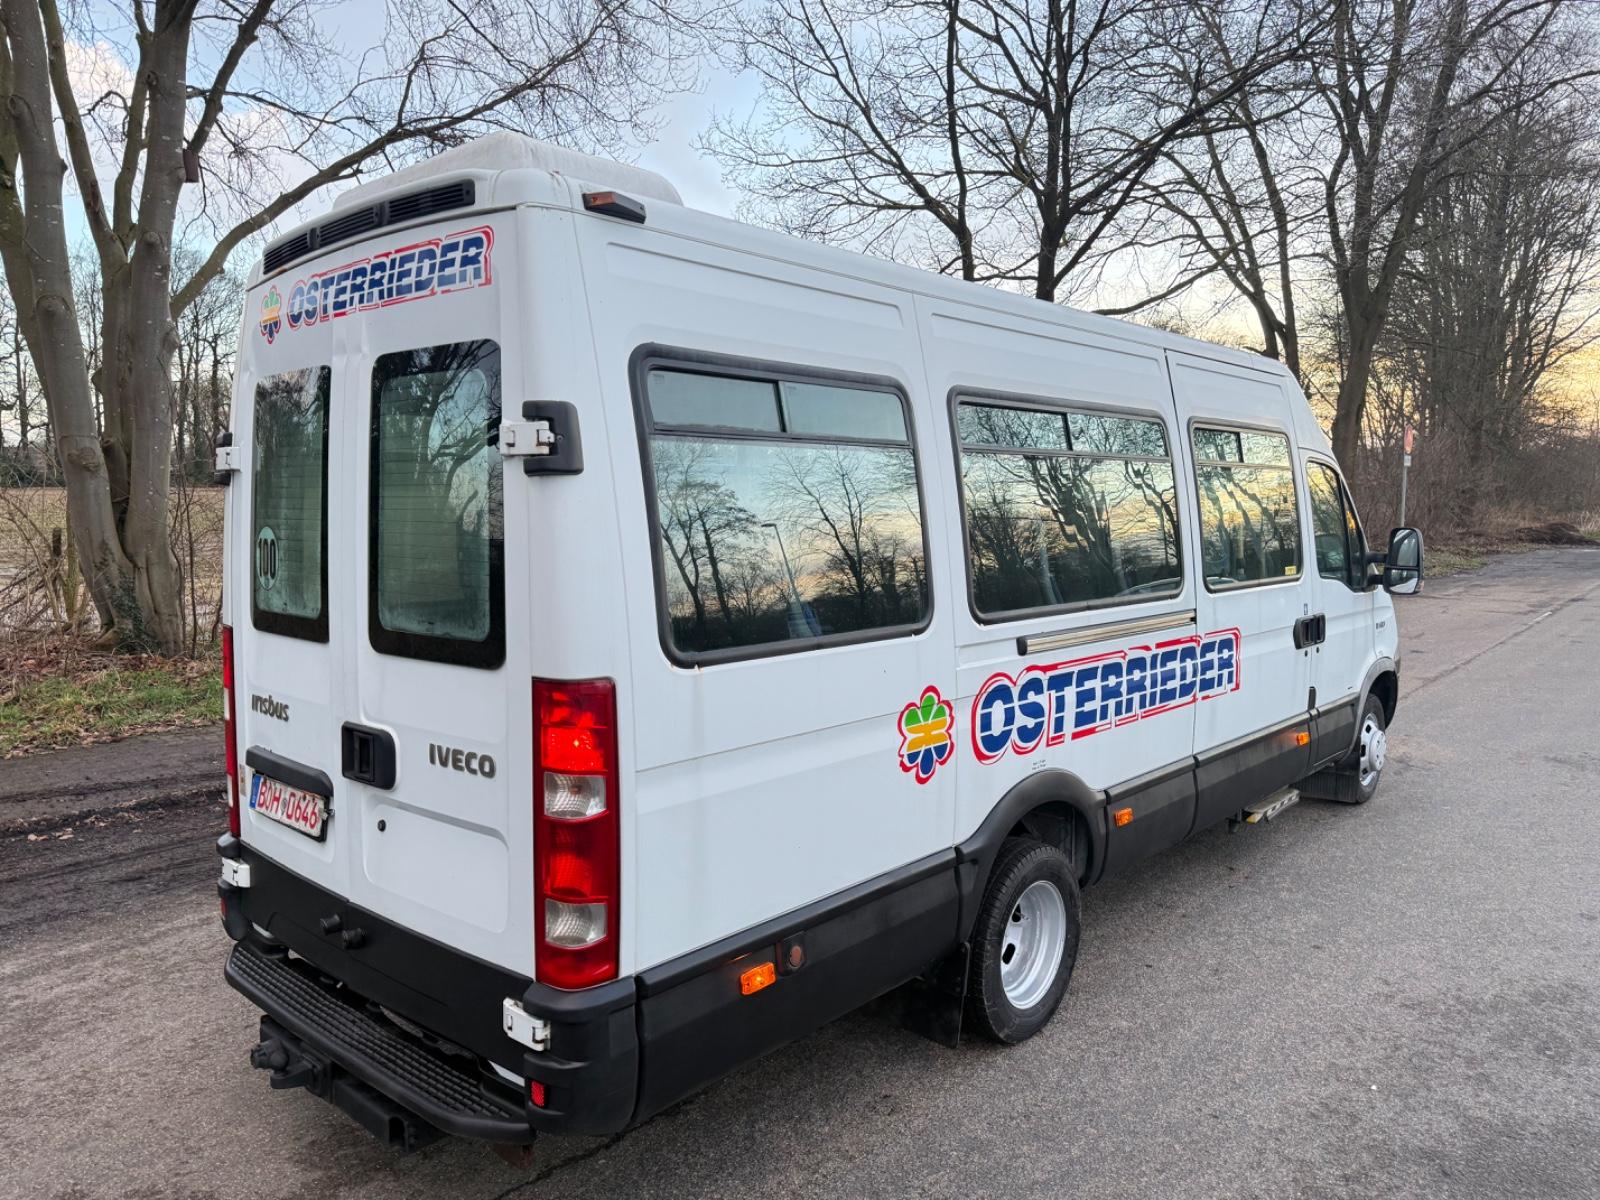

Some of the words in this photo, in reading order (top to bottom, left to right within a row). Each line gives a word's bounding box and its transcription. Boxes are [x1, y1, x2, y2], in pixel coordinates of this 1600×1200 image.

[288, 235, 485, 326] OSTERRIEDER
[258, 537, 277, 580] 100
[979, 636, 1236, 755] OSTERRIEDER
[428, 743, 497, 779] IVECO
